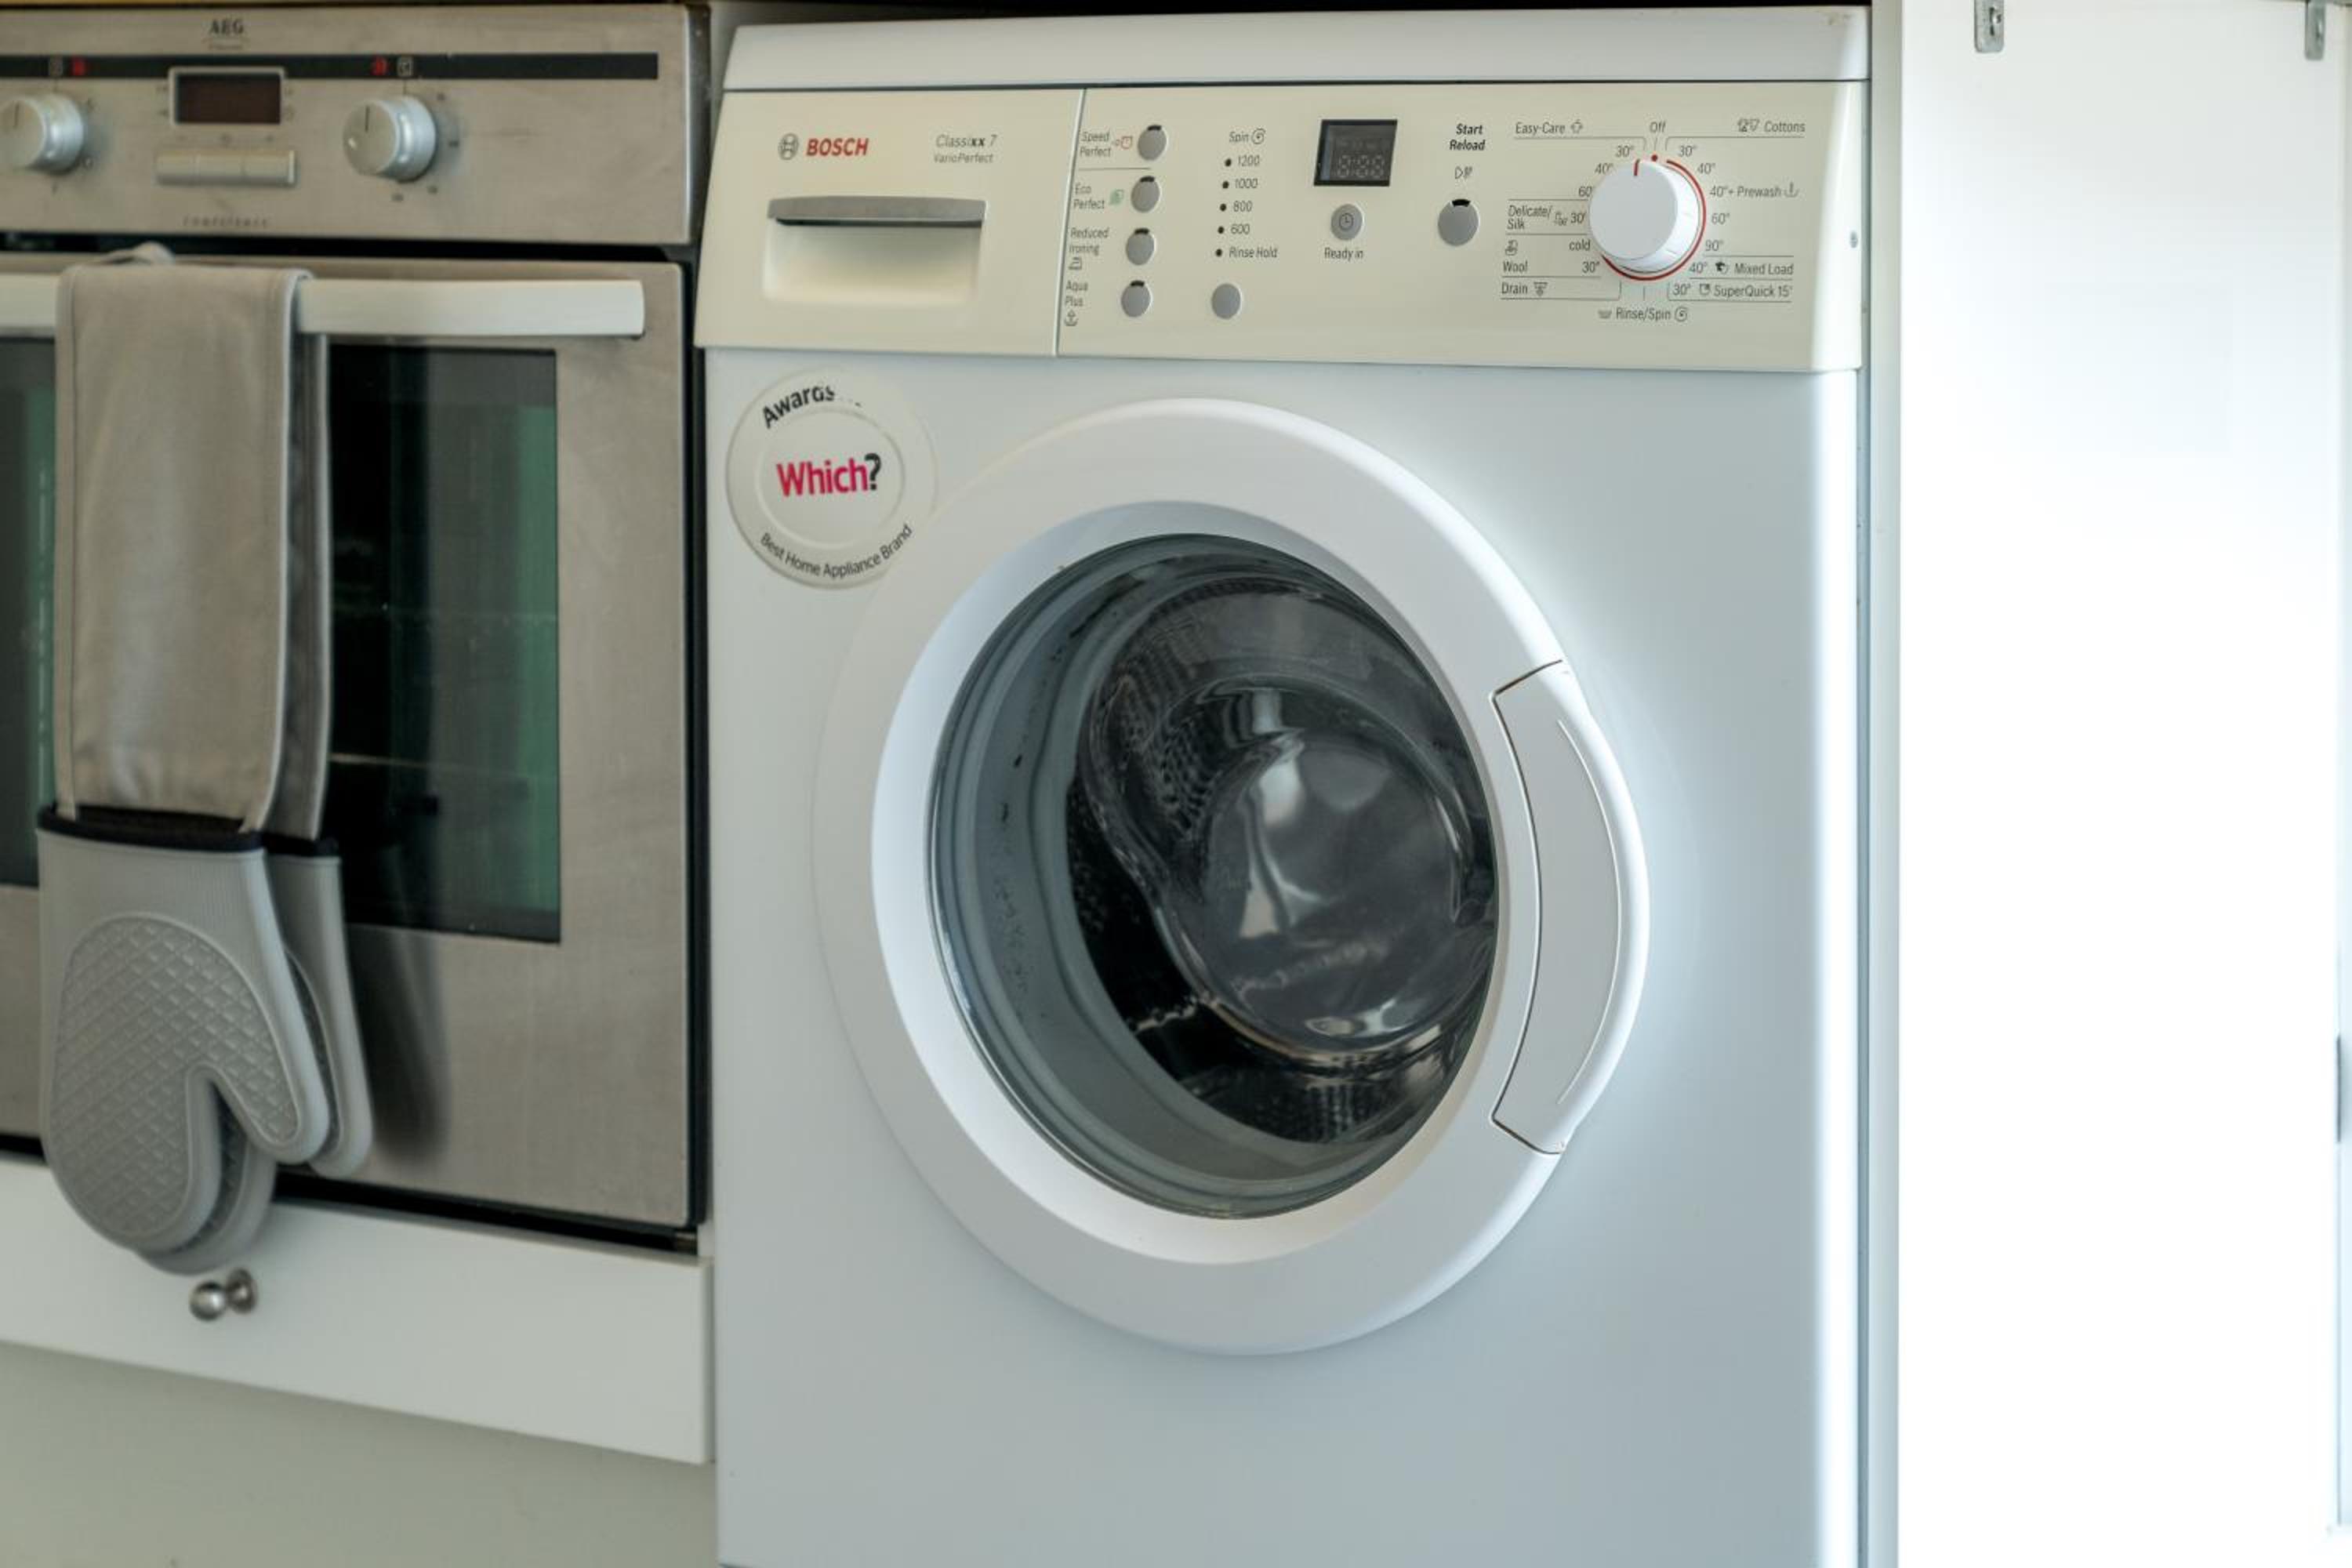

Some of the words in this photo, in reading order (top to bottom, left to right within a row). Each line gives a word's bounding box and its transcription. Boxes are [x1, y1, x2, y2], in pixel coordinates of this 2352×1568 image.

[209, 19, 245, 34] AEG
[1456, 122, 1483, 135] Start
[1515, 122, 1566, 136] Easy-Care
[1649, 121, 1667, 133] Off
[1764, 121, 1806, 132] Cottons
[936, 133, 986, 148] Classixx
[990, 133, 999, 147] 7
[1081, 131, 1110, 143] Speed
[1229, 131, 1250, 143] Spin
[806, 137, 869, 156] BOSCH
[1450, 139, 1486, 151] Reload
[1080, 146, 1111, 157] Perfect
[1679, 145, 1697, 158] 30°
[934, 152, 993, 164] VarioPerfect
[1237, 154, 1261, 167] 1200
[1697, 162, 1716, 174] 40°
[1075, 183, 1092, 195] Eco
[1234, 177, 1258, 189] 1000
[1737, 185, 1782, 198] Prewash
[1073, 198, 1105, 210] Perfect
[1232, 201, 1253, 212] 800
[1508, 205, 1553, 219] Delicate/
[1507, 218, 1525, 230] Silk
[1711, 212, 1731, 225] 60°
[1071, 227, 1109, 238] Reduced
[1230, 223, 1250, 235] 600
[1069, 244, 1100, 256] Ironing
[1568, 238, 1592, 251] cold
[1229, 245, 1254, 258] Rinse
[1255, 245, 1279, 258] Hold
[1324, 247, 1353, 261] Ready
[1354, 247, 1364, 259] in
[1503, 260, 1528, 273] Wool
[1734, 263, 1764, 274] Mixed
[1767, 263, 1795, 275] Load
[1065, 280, 1088, 292] Aqua
[1501, 281, 1528, 294] Drain
[1714, 285, 1774, 299] SuperQuick
[1065, 296, 1083, 307] Plus
[1616, 307, 1671, 321] Rinse/Spin
[776, 452, 882, 497] Which?
[760, 532, 785, 560] Best
[786, 551, 821, 576] Home
[823, 554, 881, 579] Appliance
[880, 524, 913, 560] Brand
